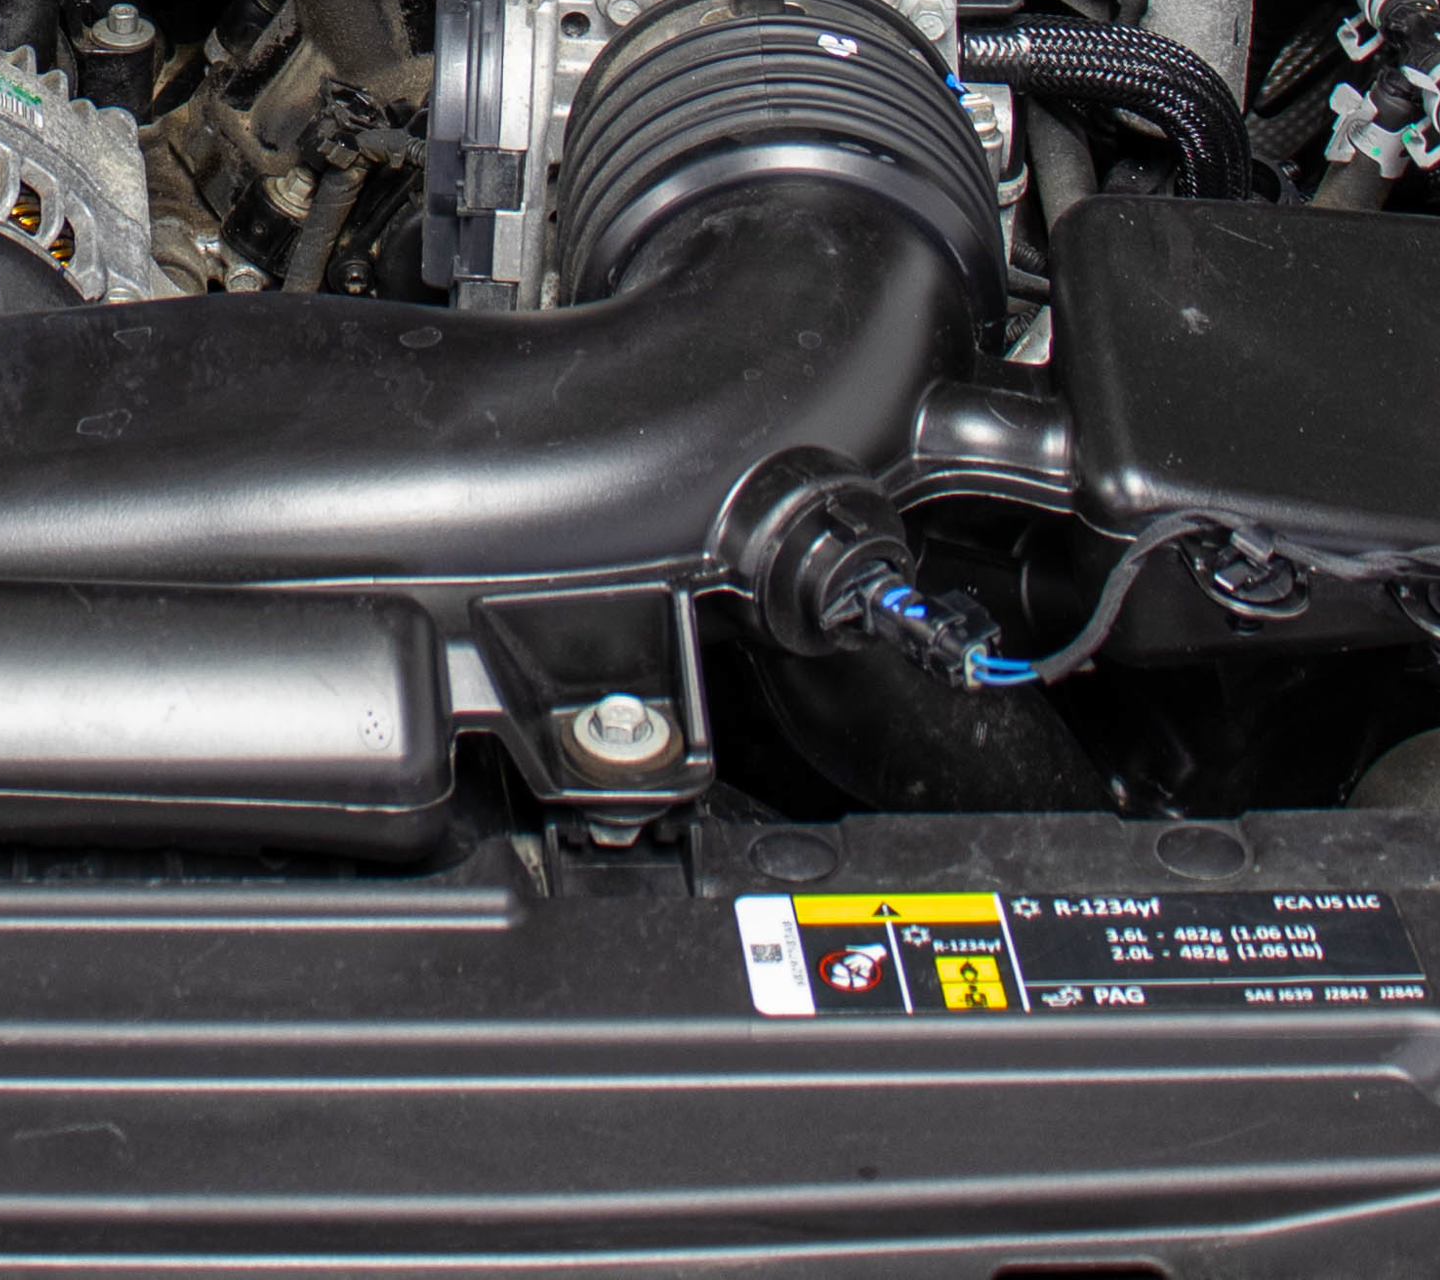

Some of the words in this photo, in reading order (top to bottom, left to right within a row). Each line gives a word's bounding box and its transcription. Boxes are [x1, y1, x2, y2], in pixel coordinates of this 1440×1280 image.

[1053, 897, 1161, 918] R-1234yf
[1273, 895, 1312, 910] FCA
[1315, 895, 1344, 909] US
[1347, 894, 1381, 909] LLC
[1105, 927, 1148, 943] 3.6L
[1173, 925, 1223, 944] 482g
[1230, 924, 1281, 942] (1.06
[1285, 924, 1317, 942] Lb)
[932, 939, 1002, 954] R-1234yf
[1111, 945, 1154, 961] 2.0L
[1179, 944, 1229, 963] 482g
[1236, 943, 1287, 961] (1.06
[1291, 942, 1324, 960] Lb)
[1093, 986, 1145, 1005] PAG
[1244, 988, 1274, 1002] SAE
[1277, 987, 1314, 1001] J639
[1324, 986, 1368, 1001] J2842
[1380, 985, 1424, 1000] J2845
